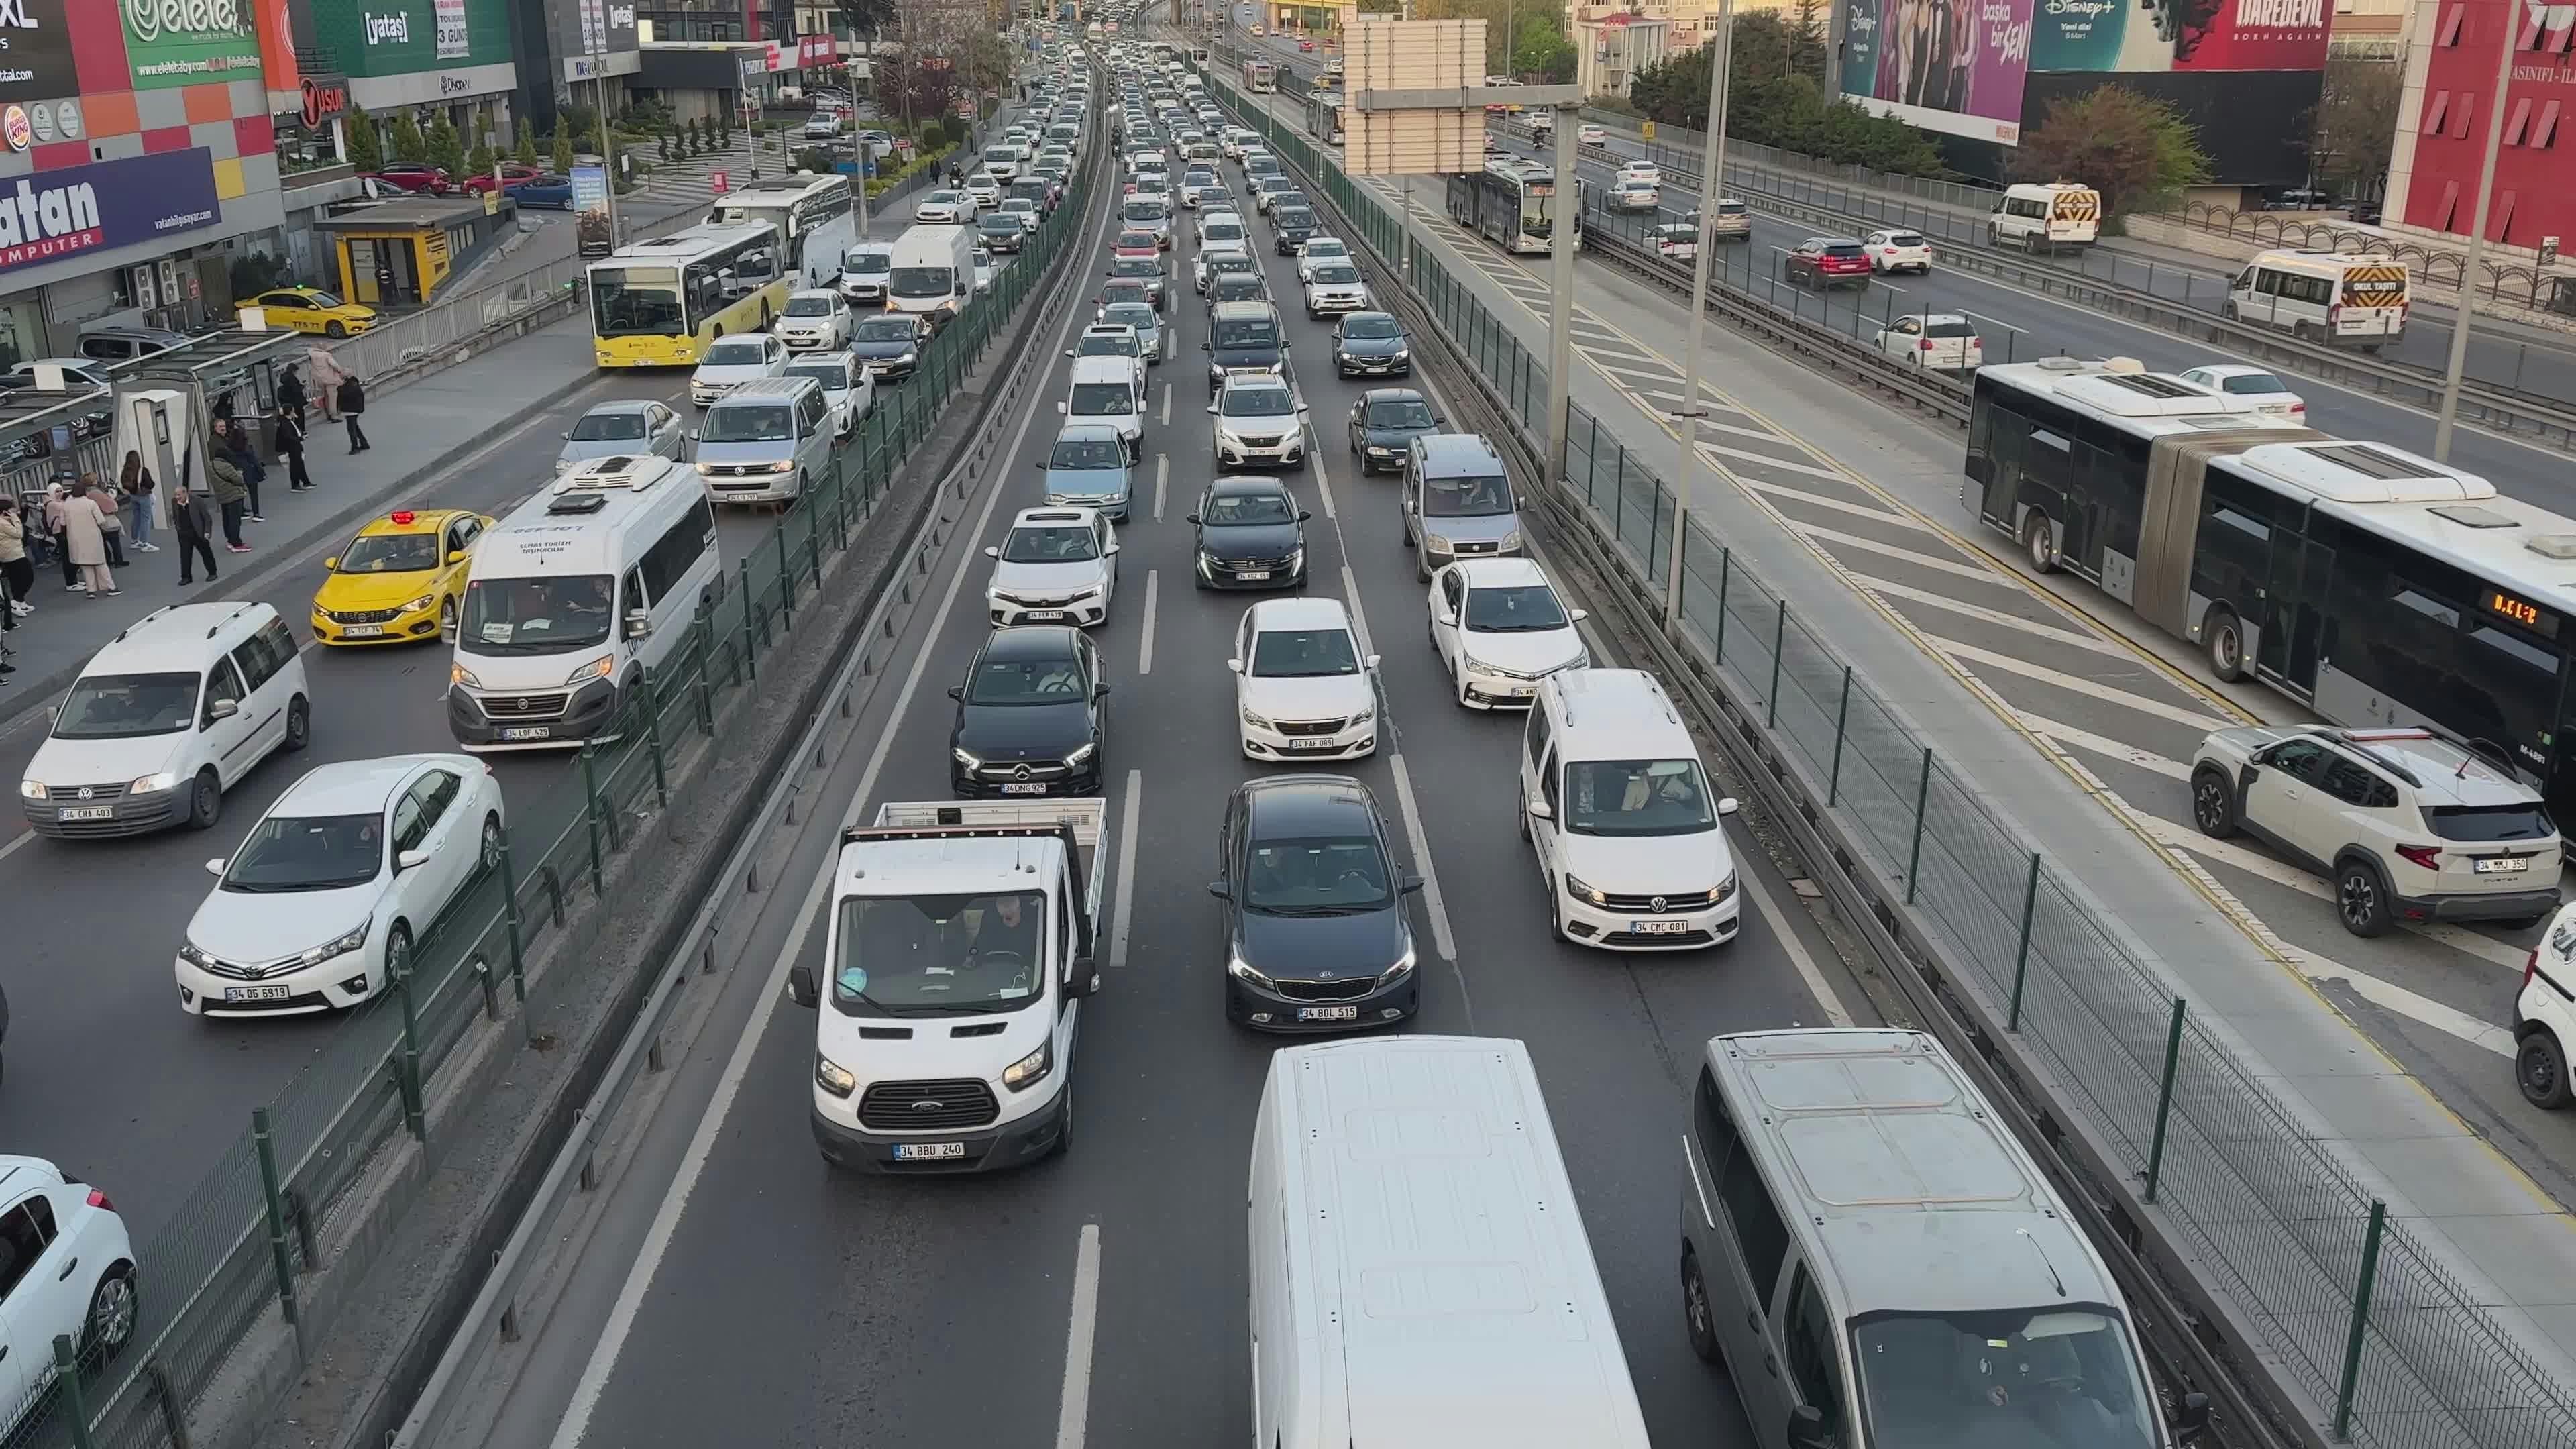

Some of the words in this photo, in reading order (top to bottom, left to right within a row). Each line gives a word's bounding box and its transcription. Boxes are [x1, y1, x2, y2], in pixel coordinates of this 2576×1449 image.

[439, 30, 445, 43] 3
[9, 115, 25, 130] BURGER
[12, 122, 28, 140] KING
[154, 210, 213, 230] vatanbilgisayar.com
[0, 233, 93, 264] MPUTER
[2353, 282, 2372, 290] OKUL
[1032, 783, 1045, 792] 925
[65, 810, 74, 820] 34
[78, 810, 92, 818] CHA
[96, 808, 111, 817] 403
[2479, 861, 2489, 870] 34
[2512, 859, 2526, 869] 350
[1637, 924, 1646, 932] 34
[1670, 922, 1686, 931] 081
[231, 989, 244, 999] 34
[247, 988, 258, 998] DG
[1303, 1009, 1314, 1018] 34
[1338, 1007, 1355, 1017] 515
[901, 1146, 913, 1157] 34
[916, 1145, 936, 1156] BBU
[942, 1144, 961, 1155] 240
